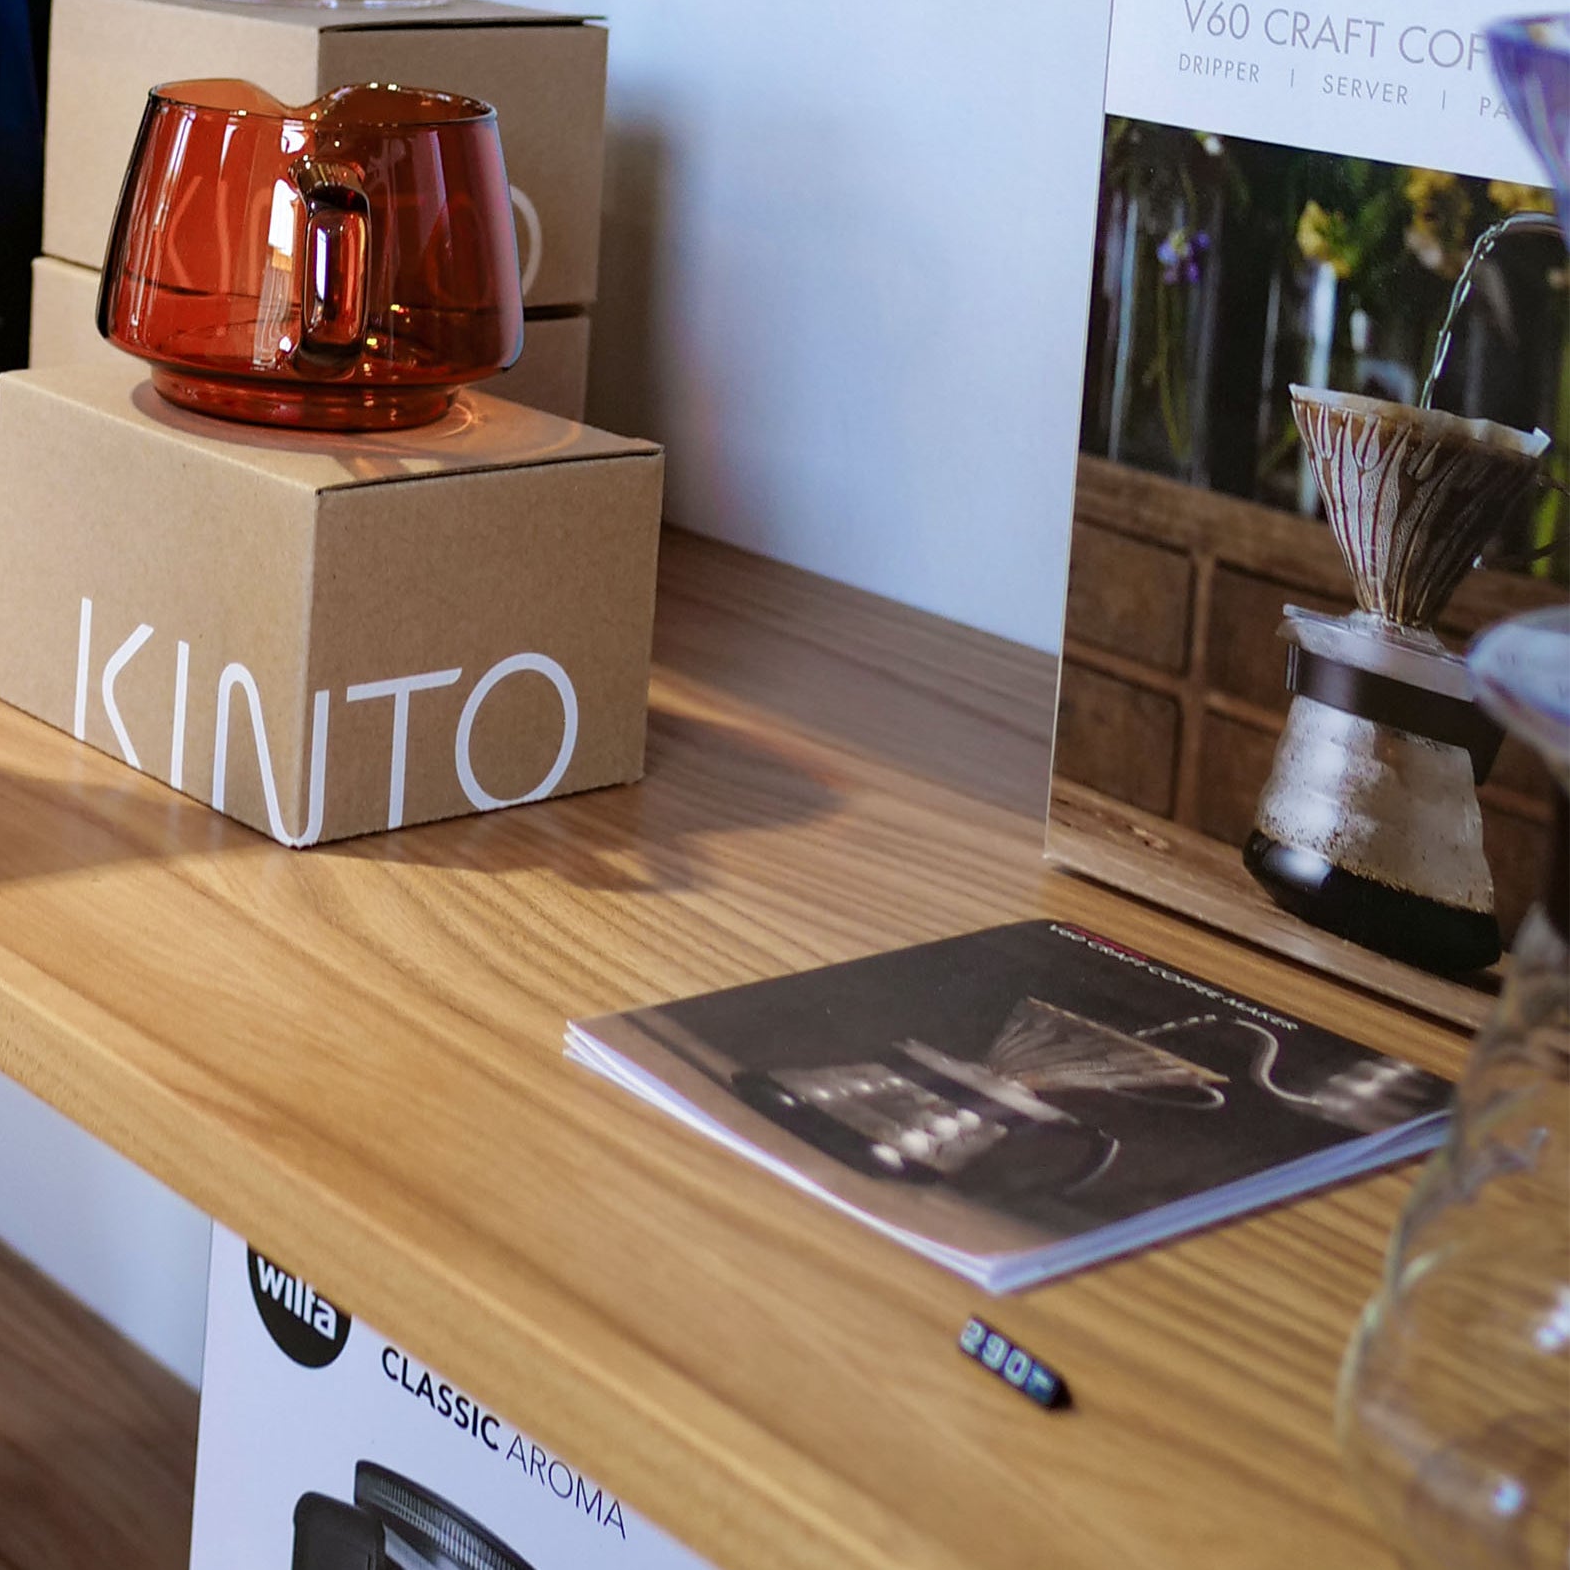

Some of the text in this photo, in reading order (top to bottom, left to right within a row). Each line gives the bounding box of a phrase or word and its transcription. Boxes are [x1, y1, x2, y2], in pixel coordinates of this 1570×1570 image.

[1264, 8, 1385, 58] CRAFT
[1179, 52, 1260, 84] DRIPPER
[1323, 74, 1409, 106] SERVER
[73, 596, 579, 850] KINTO
[256, 1254, 339, 1341] wilfa
[381, 1344, 627, 1541] CLASSIC AROMA
